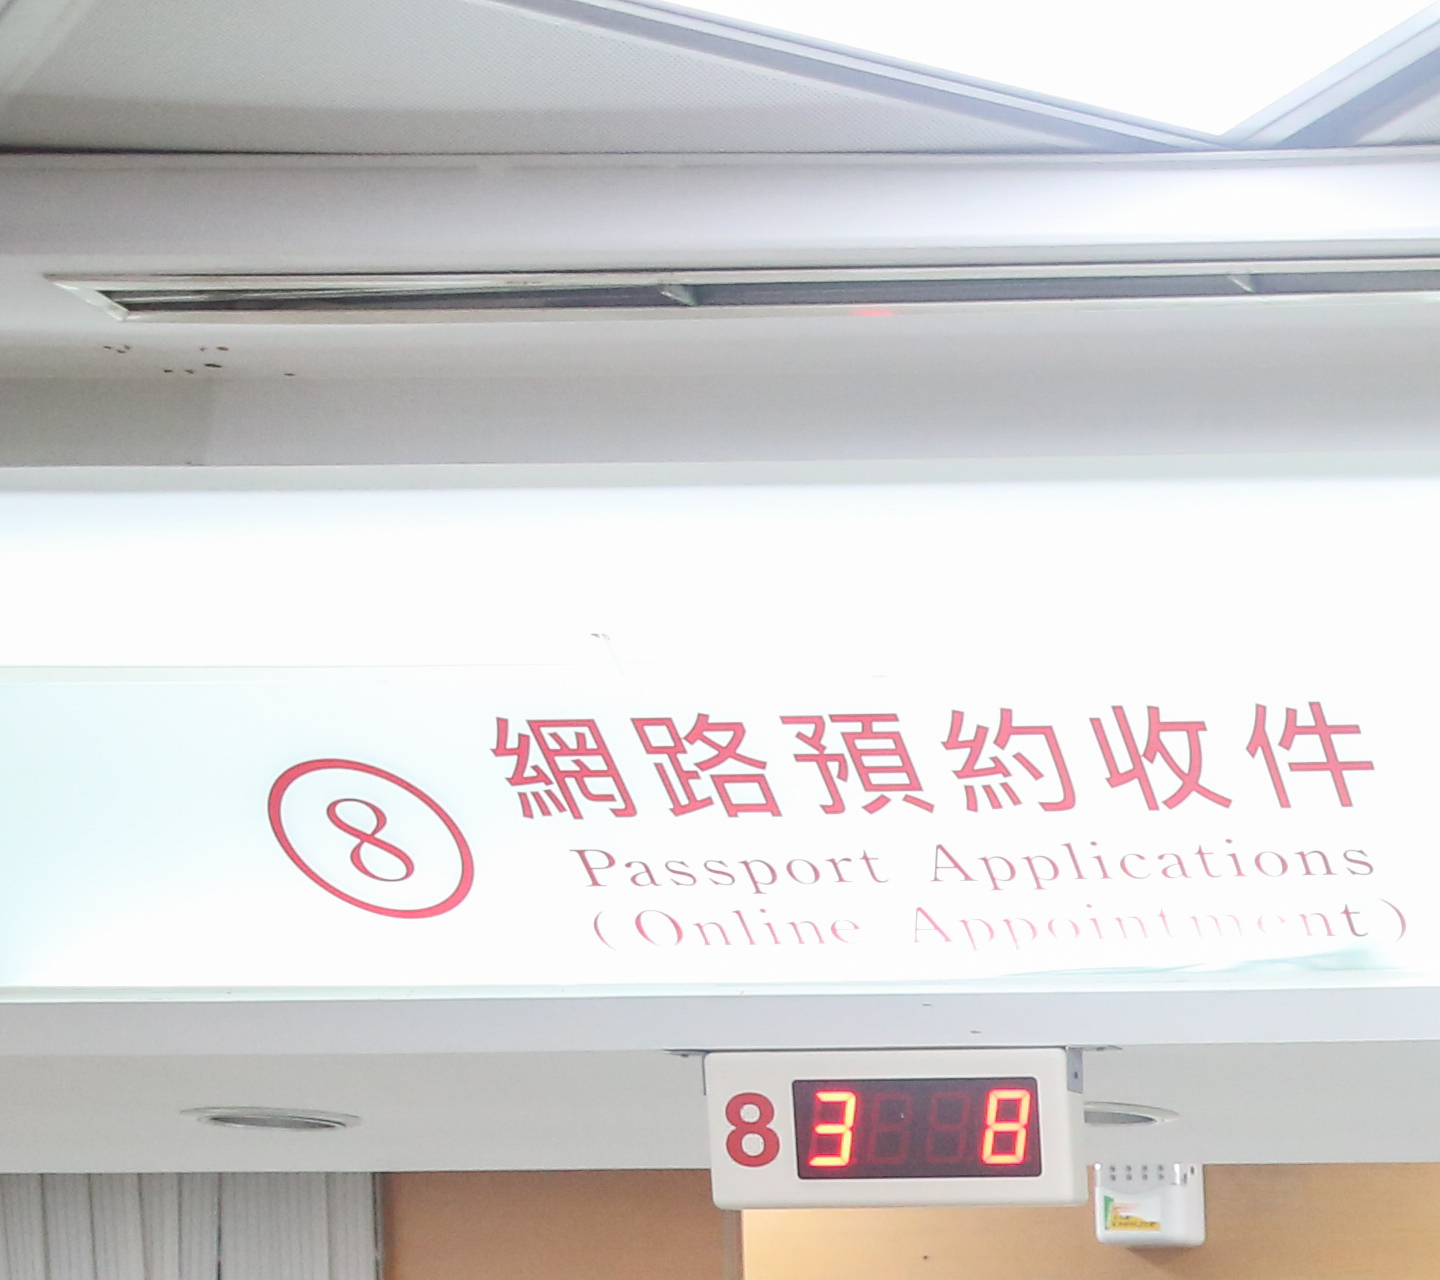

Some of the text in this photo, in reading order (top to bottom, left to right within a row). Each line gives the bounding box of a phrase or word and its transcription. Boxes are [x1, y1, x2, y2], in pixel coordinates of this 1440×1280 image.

[490, 698, 1378, 824] 網路預約收件
[324, 795, 415, 884] 8
[574, 835, 1378, 896] Passport Applications
[725, 1091, 780, 1167] 8
